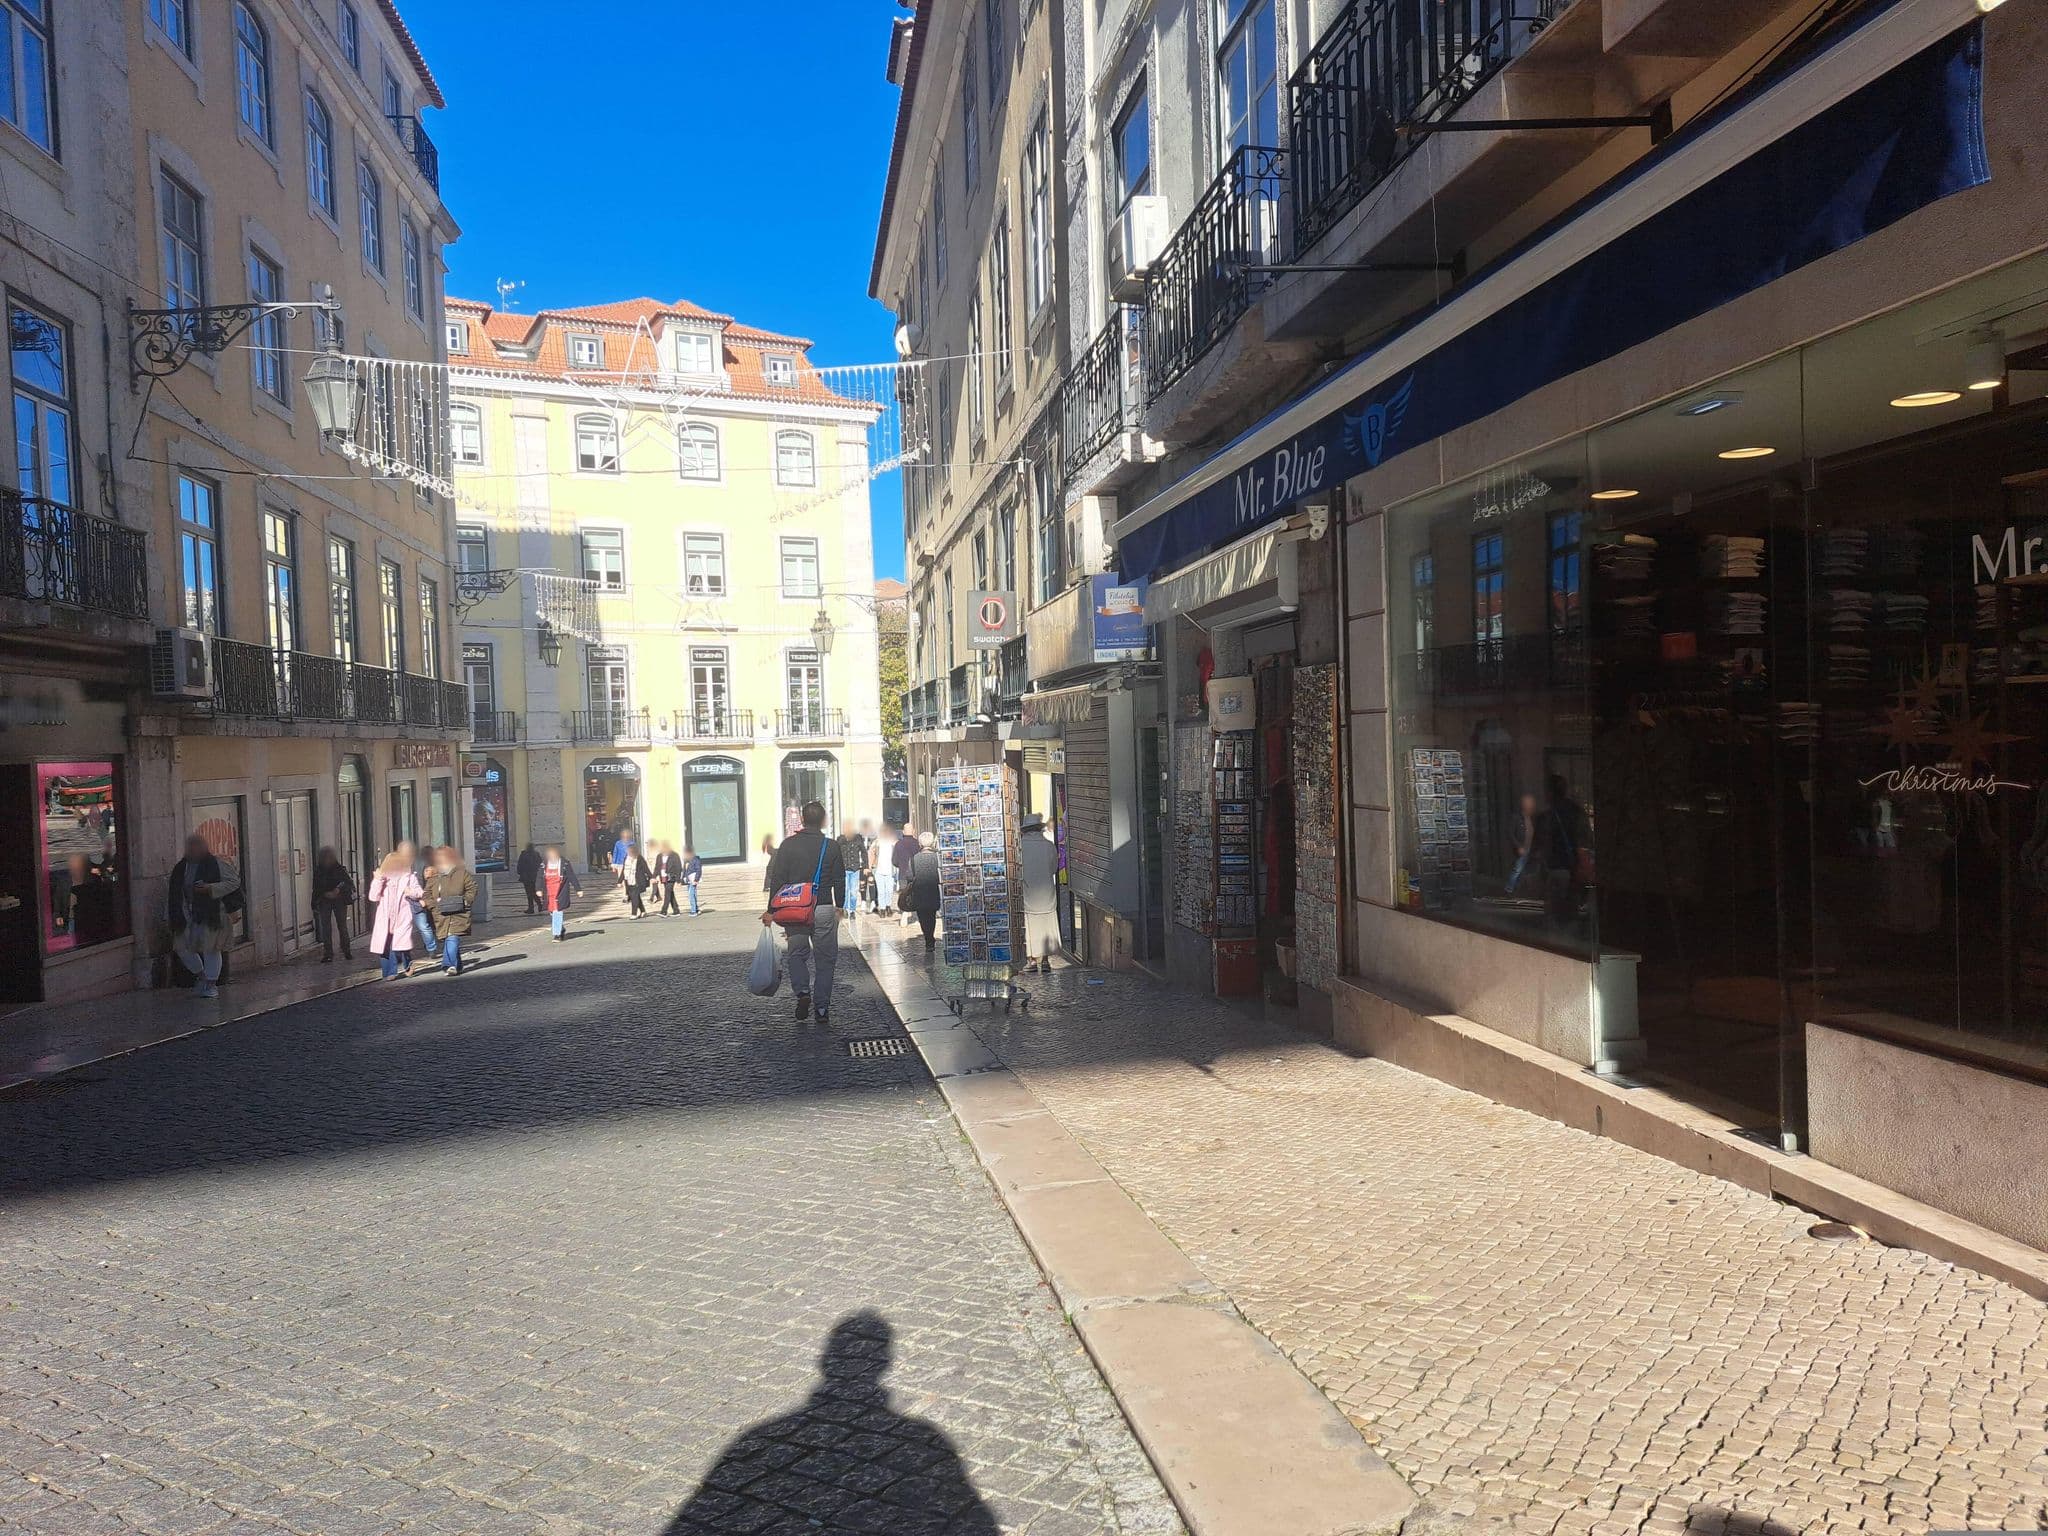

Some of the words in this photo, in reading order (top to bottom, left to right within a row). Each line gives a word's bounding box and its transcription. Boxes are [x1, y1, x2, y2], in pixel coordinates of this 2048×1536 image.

[1368, 414, 1380, 450] B
[1235, 467, 1265, 527] Mr.
[1273, 440, 1326, 507] Blue
[1972, 526, 2048, 585] Mr.
[973, 635, 1006, 643] swatch
[589, 762, 636, 773] TEZENIS
[689, 762, 734, 773] TEZENIS
[787, 759, 829, 770] TEZENIS
[1858, 765, 2030, 795] Christmas
